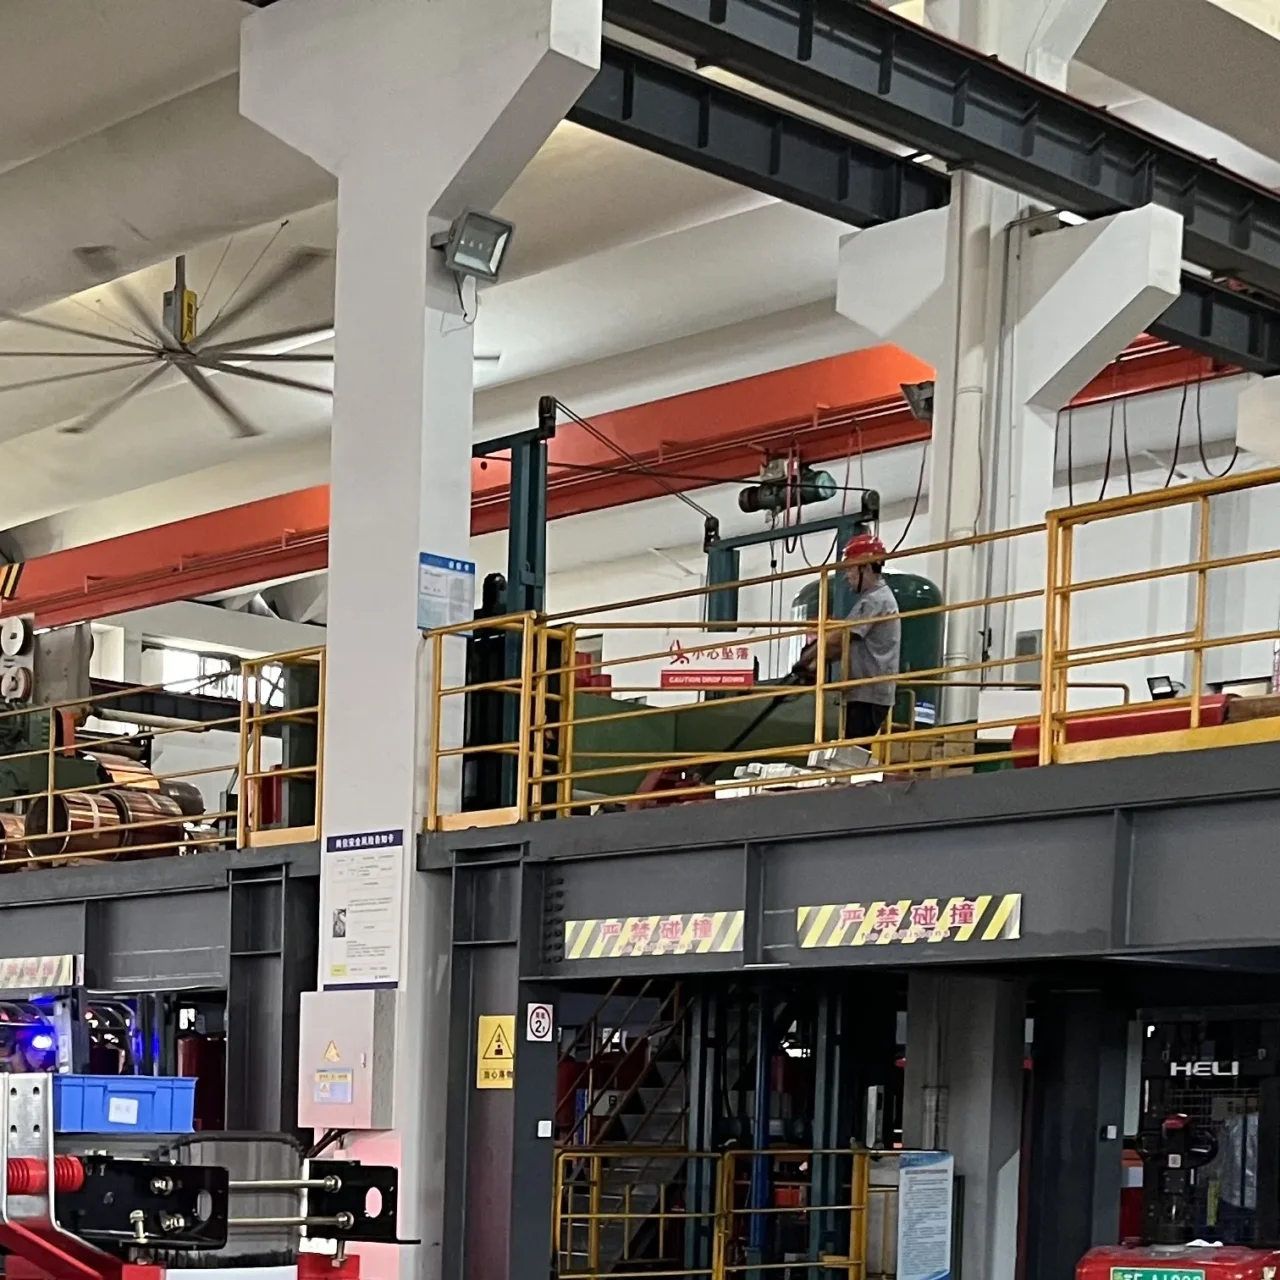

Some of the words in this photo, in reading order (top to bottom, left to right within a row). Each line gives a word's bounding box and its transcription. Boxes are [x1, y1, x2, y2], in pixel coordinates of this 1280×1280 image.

[692, 647, 749, 660] 小心坠落
[841, 902, 974, 930] 严禁碰撞
[601, 917, 713, 942] 严禁碰撞
[1170, 1061, 1239, 1076] HELI
